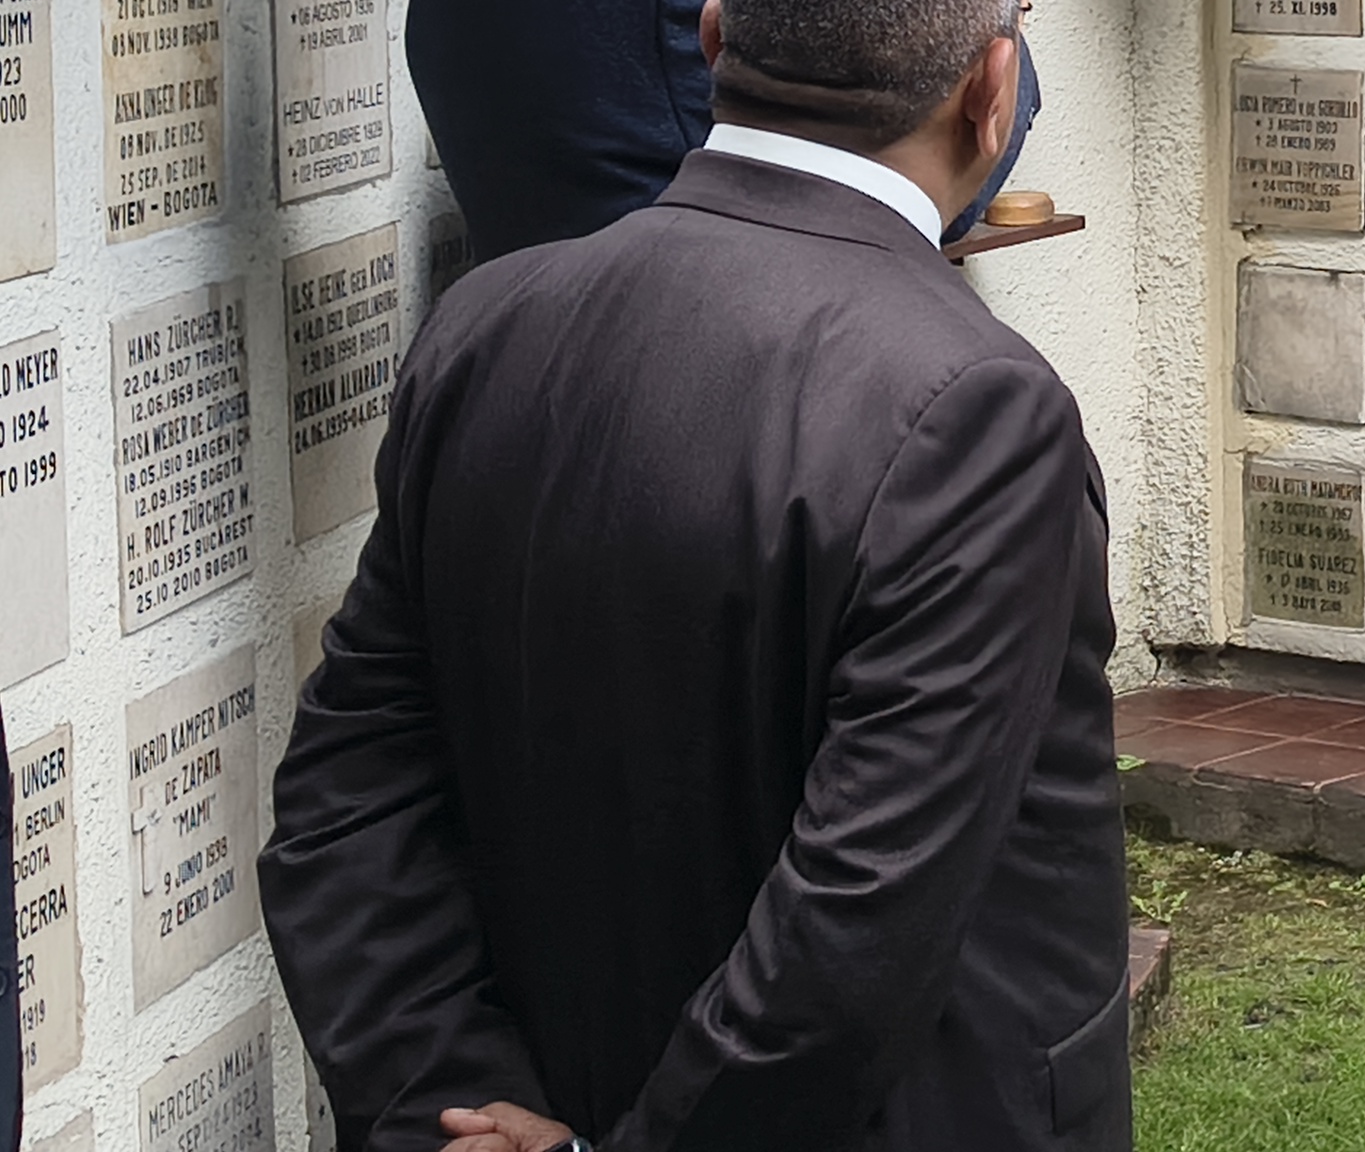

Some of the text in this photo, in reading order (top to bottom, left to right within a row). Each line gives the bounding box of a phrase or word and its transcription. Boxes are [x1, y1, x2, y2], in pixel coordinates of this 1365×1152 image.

[282, 82, 384, 127] HEINZ HALLE
[107, 198, 145, 232] WIEN
[15, 347, 58, 392] MEYER
[144, 514, 177, 553] ROLF
[21, 746, 66, 800] UNGER
[129, 732, 168, 781] INGRID
[181, 746, 222, 795] ZAPATA
[25, 799, 65, 841] BERLIN
